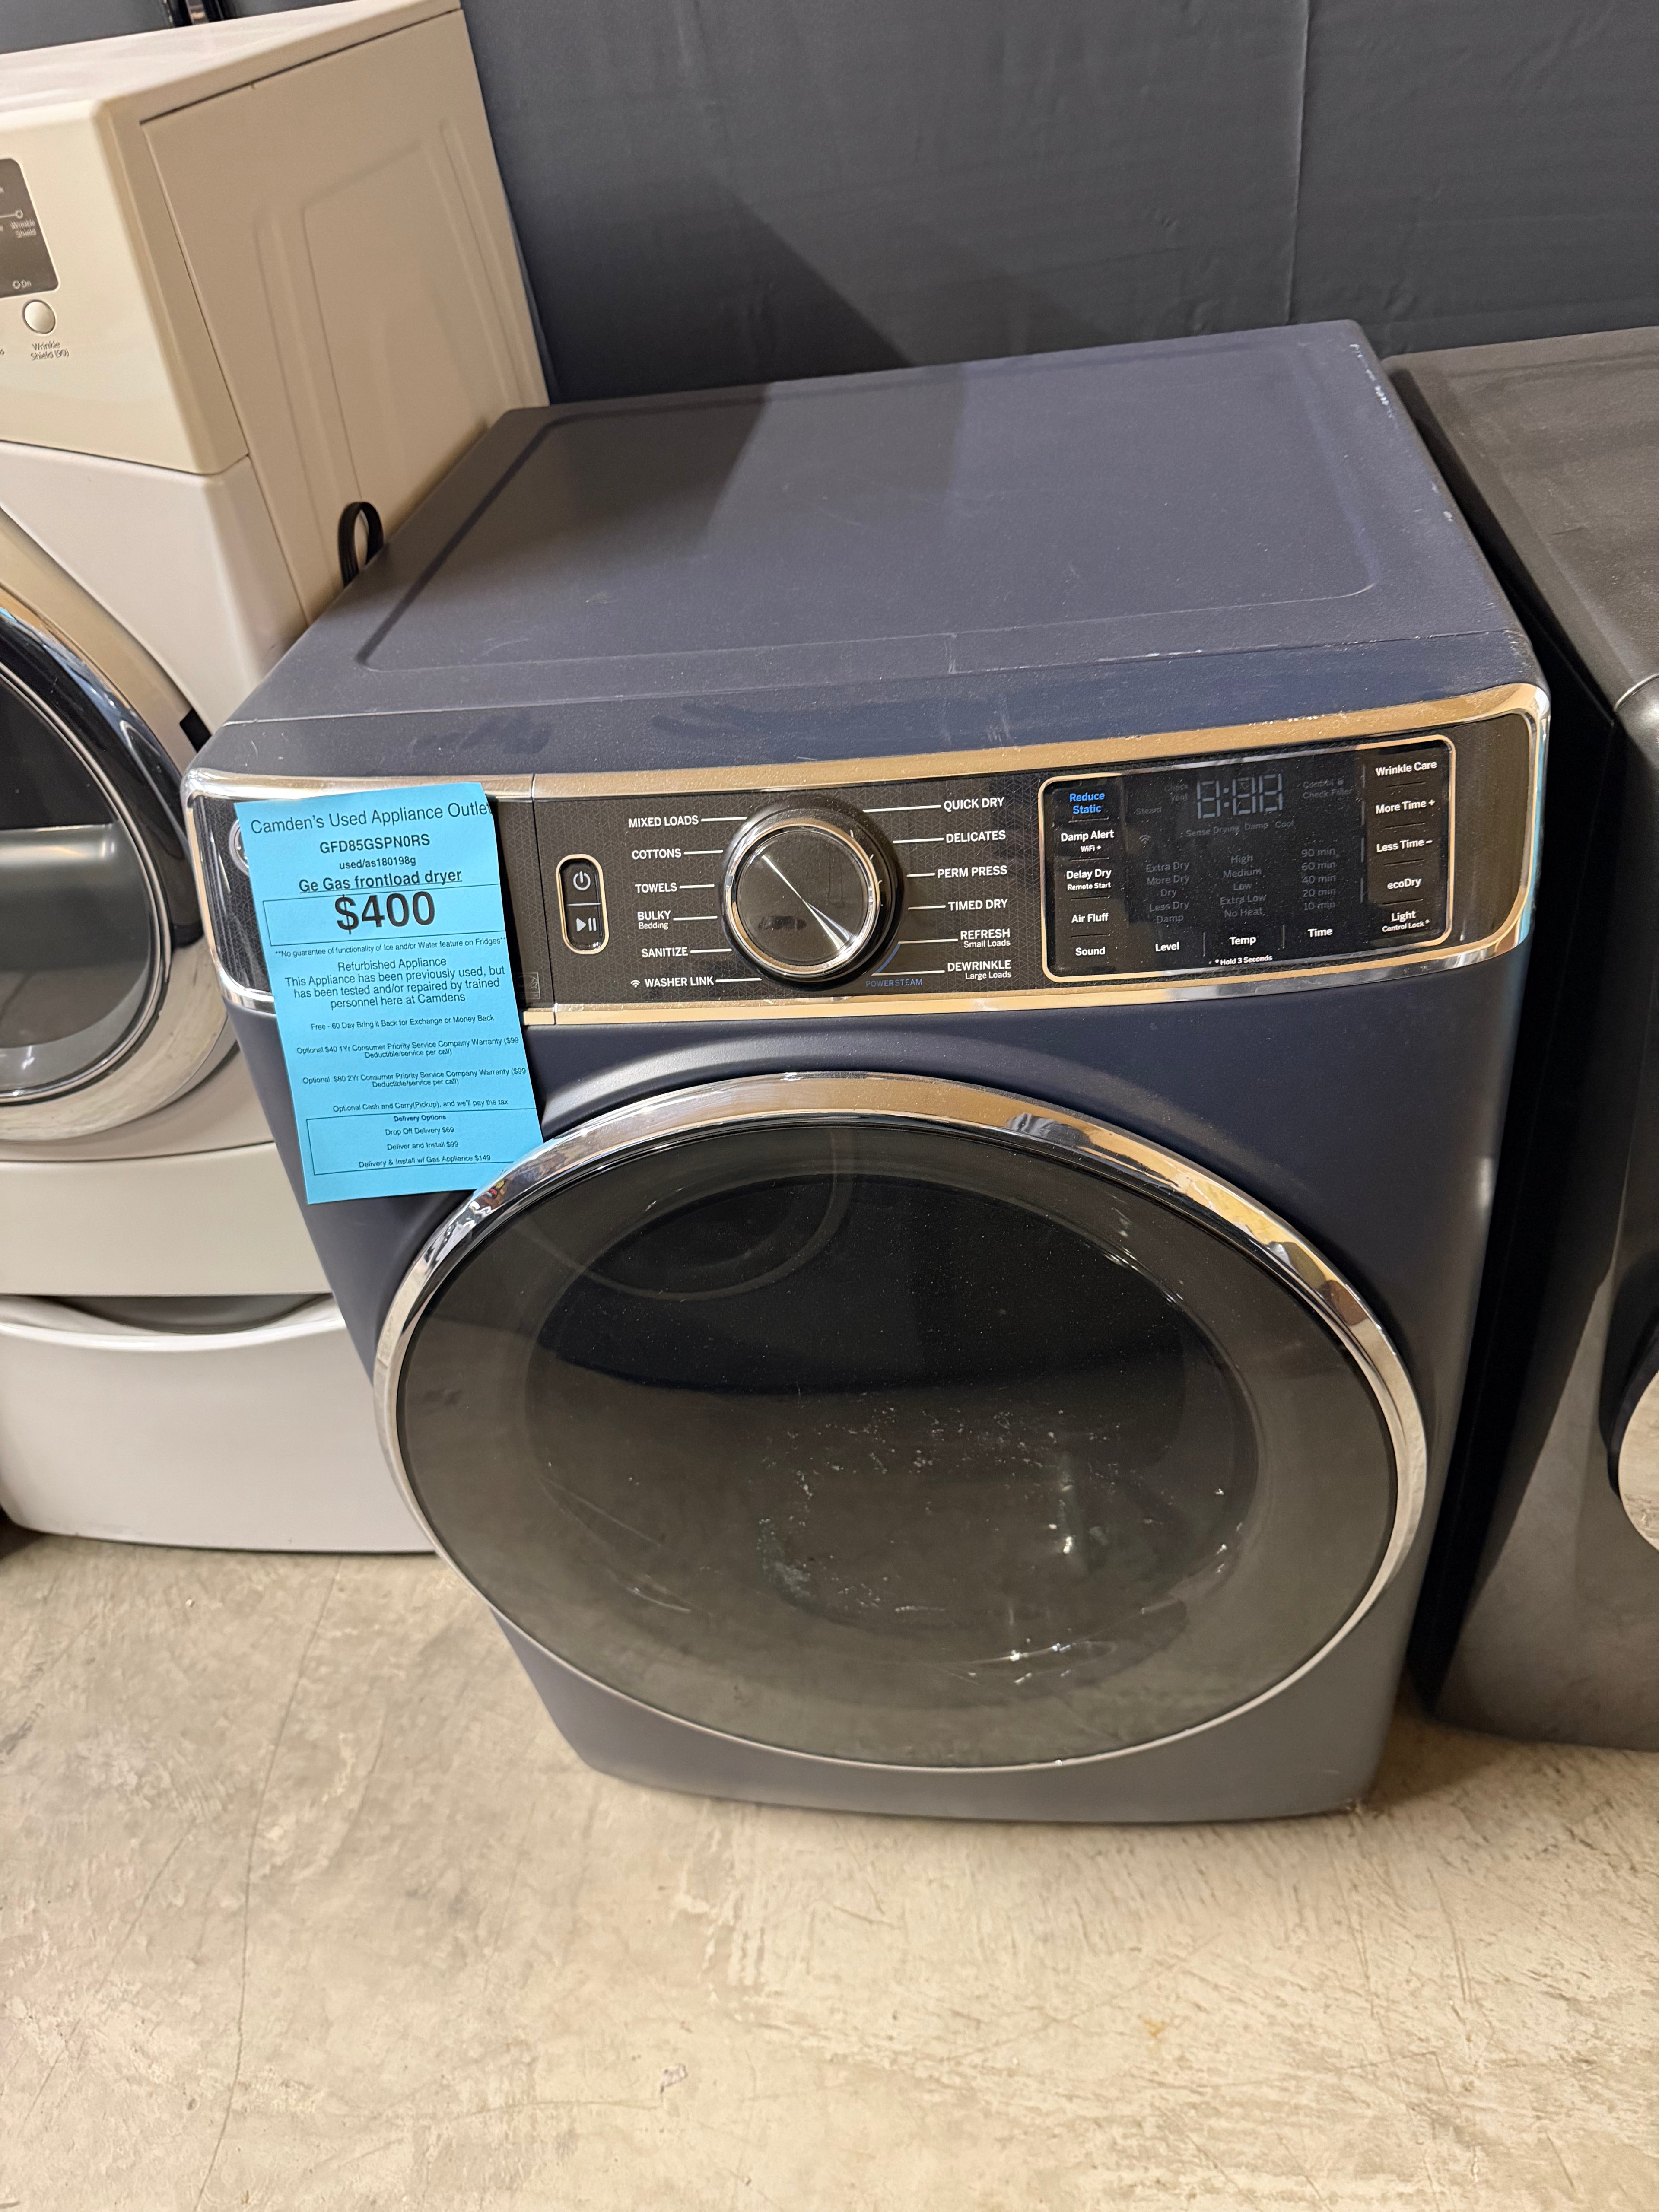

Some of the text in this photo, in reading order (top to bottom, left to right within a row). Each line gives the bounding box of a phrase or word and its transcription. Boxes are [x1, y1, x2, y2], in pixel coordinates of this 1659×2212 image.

[1375, 762, 1437, 776] Wrinkle Care
[1070, 792, 1105, 802] Reduce
[944, 797, 1004, 812] QUICK DRY
[1073, 804, 1102, 814] Static
[1376, 801, 1426, 814] More Time
[251, 815, 324, 834] Camden's
[329, 810, 367, 827] Used
[372, 807, 443, 826] Appliance
[629, 815, 699, 828] MIXED LOADS
[946, 830, 1006, 843] DELICATES
[1061, 830, 1114, 842] Damp Alert
[320, 833, 430, 854] GFD85GSPN0RS
[1376, 839, 1424, 852] Less Time
[632, 848, 681, 860] COTTONS
[1231, 854, 1253, 864] High
[339, 856, 416, 870] used/as180198g
[938, 865, 1007, 878] PERM PRESS
[1066, 869, 1112, 880] Delay Dry
[1223, 868, 1262, 878] Medium
[299, 870, 462, 892] Ge Gas frontload dryer
[1387, 878, 1421, 889] ecoDry
[635, 882, 677, 893] TOWELS
[948, 899, 1008, 911] TIMED DRY
[335, 891, 435, 935] $400
[637, 910, 671, 921] BULKY
[1071, 912, 1109, 923] Air Fluff
[1391, 911, 1416, 922] Light
[1156, 915, 1184, 924] Damp
[1307, 928, 1333, 937] Time
[1382, 923, 1407, 932] Control
[960, 928, 1010, 940] REFRESH
[1155, 941, 1179, 951] Level
[1229, 937, 1256, 945] Temp
[293, 949, 326, 958] guarantee
[336, 945, 374, 953] functionality
[642, 947, 688, 957] SANITIZE
[1075, 947, 1105, 956] Sound
[338, 957, 446, 972] Refurbished Appliance
[1243, 955, 1273, 963] Seconds
[947, 960, 1011, 972] DEWRINKLE
[284, 966, 505, 987] This Appliance has been previously used, but
[644, 976, 714, 988] WASHER LINK
[965, 973, 987, 981] Large
[294, 977, 500, 998] has been tested and/or repaired by trained
[331, 993, 465, 1011] personnel here at Camdens
[297, 1047, 324, 1055] Optional
[504, 1037, 519, 1045] ($99
[364, 1050, 424, 1058] Deductible/service
[333, 1104, 361, 1113] Optional
[395, 1101, 441, 1109] Carry(Pickup),
[359, 1160, 386, 1169] Delivery
